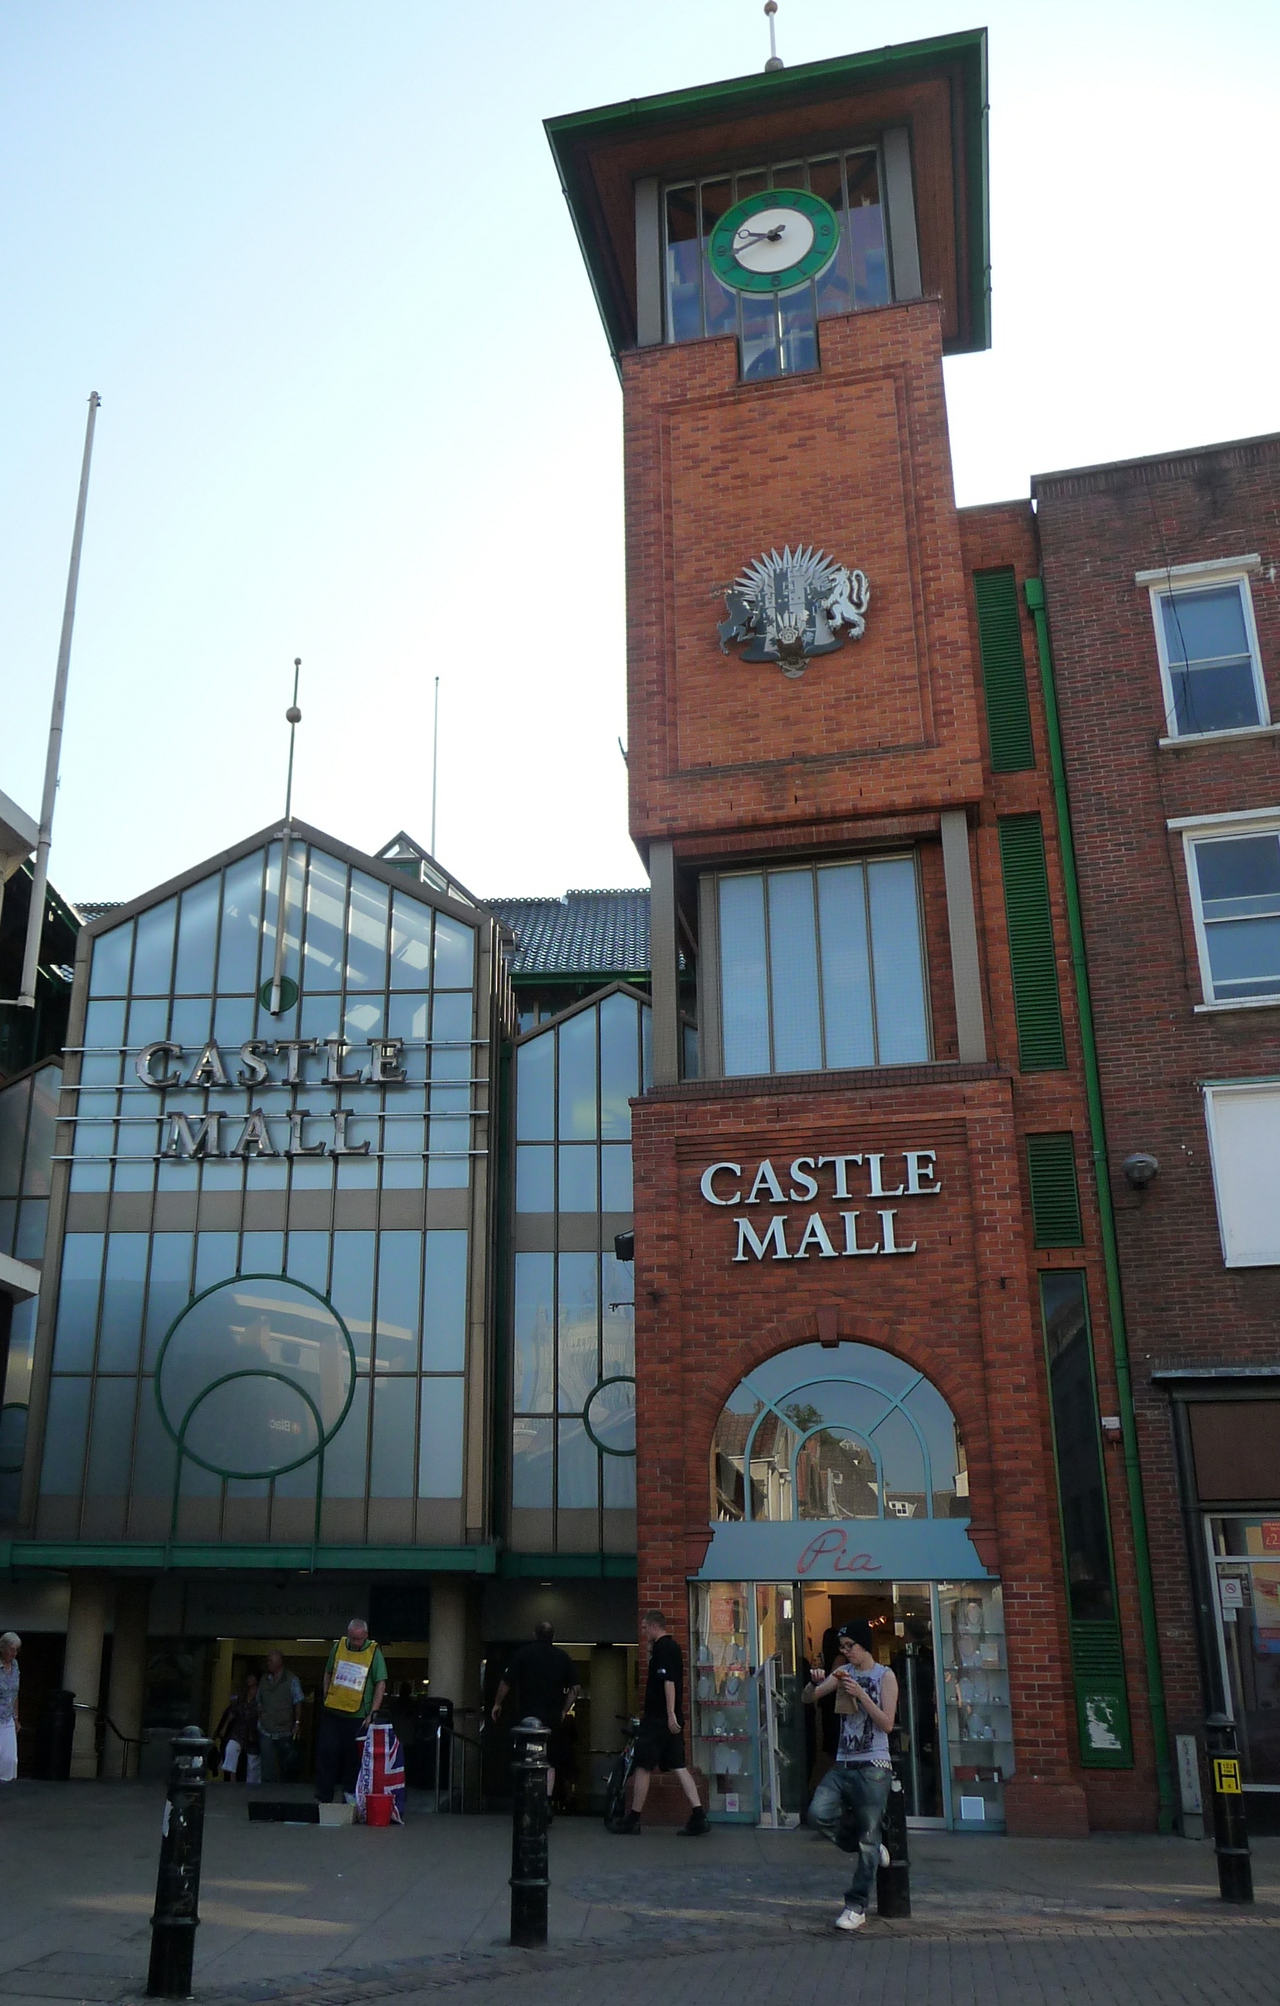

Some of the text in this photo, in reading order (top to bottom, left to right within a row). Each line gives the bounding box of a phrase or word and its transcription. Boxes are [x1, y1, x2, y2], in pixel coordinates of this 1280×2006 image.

[717, 245, 727, 256] 9
[820, 224, 831, 236] 3
[771, 275, 781, 286] 6
[135, 1036, 408, 1088] CASTLE
[162, 1107, 371, 1160] MALL
[700, 1149, 942, 1206] CASTLE
[731, 1209, 918, 1262] MALL
[797, 1528, 883, 1574] Pia
[205, 1602, 265, 1616] Welcome
[269, 1603, 281, 1616] to
[285, 1602, 325, 1617] Castle
